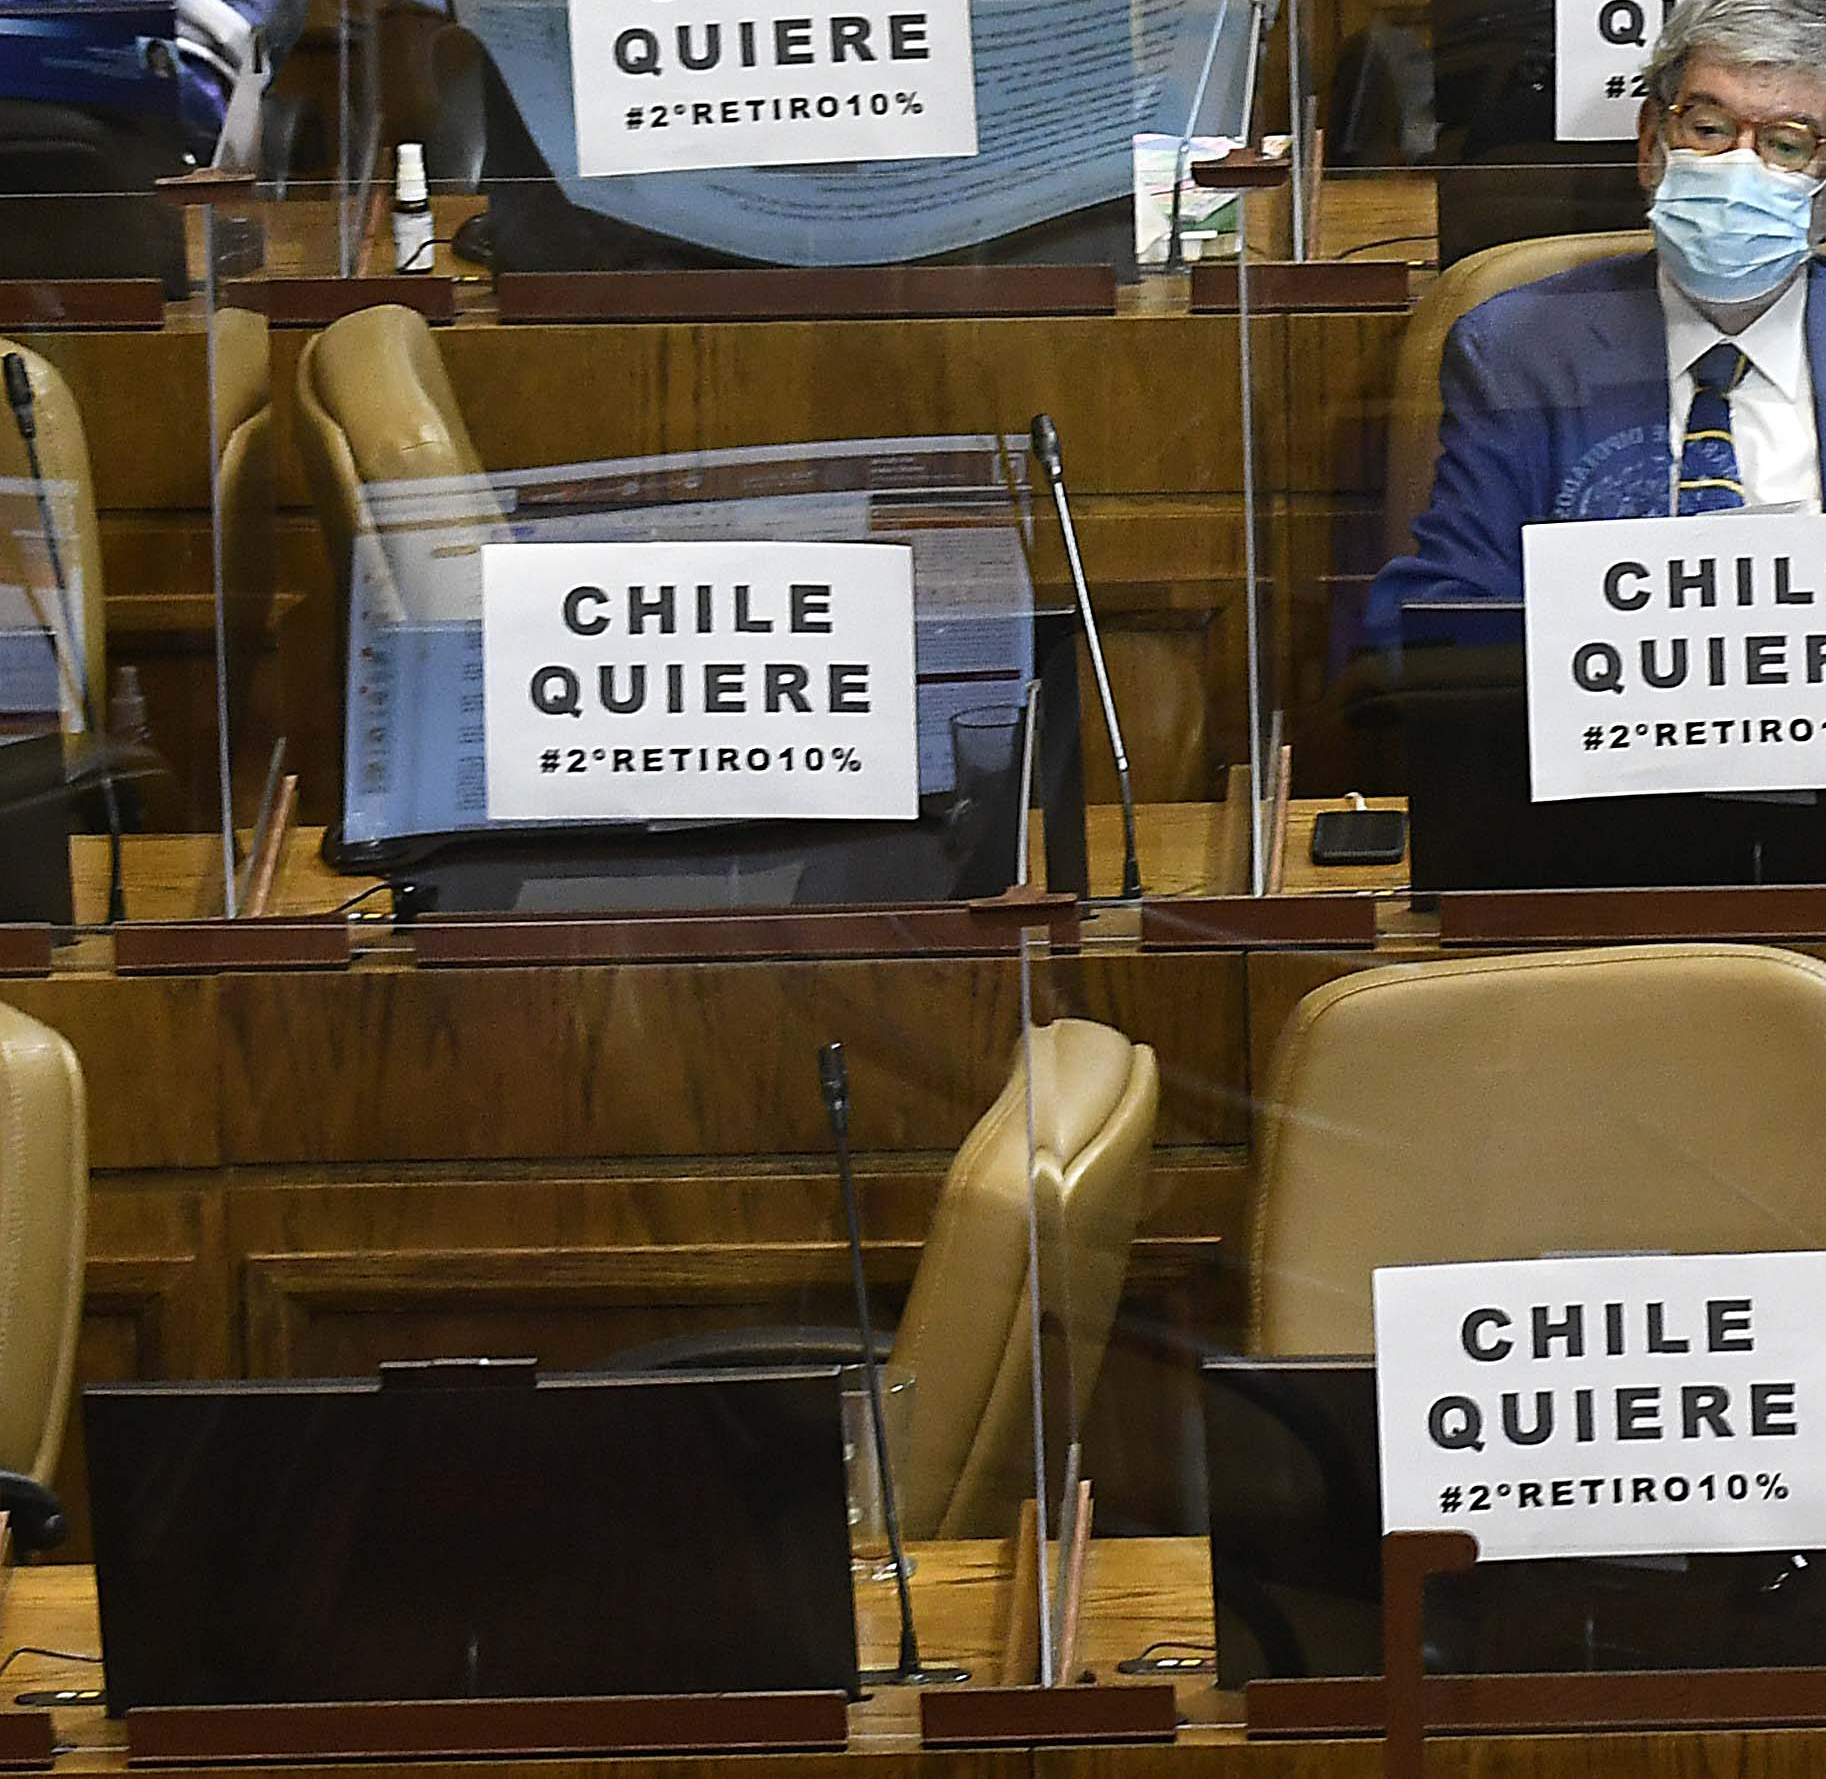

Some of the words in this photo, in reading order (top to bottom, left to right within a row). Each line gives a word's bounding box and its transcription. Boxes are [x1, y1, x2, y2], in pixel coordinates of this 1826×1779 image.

[615, 14, 929, 75] QUIERE
[564, 585, 832, 636] CHILE
[531, 664, 870, 718] QUIERE
[1462, 1299, 1753, 1362] CHILE
[1428, 1383, 1796, 1452] QUIERE
